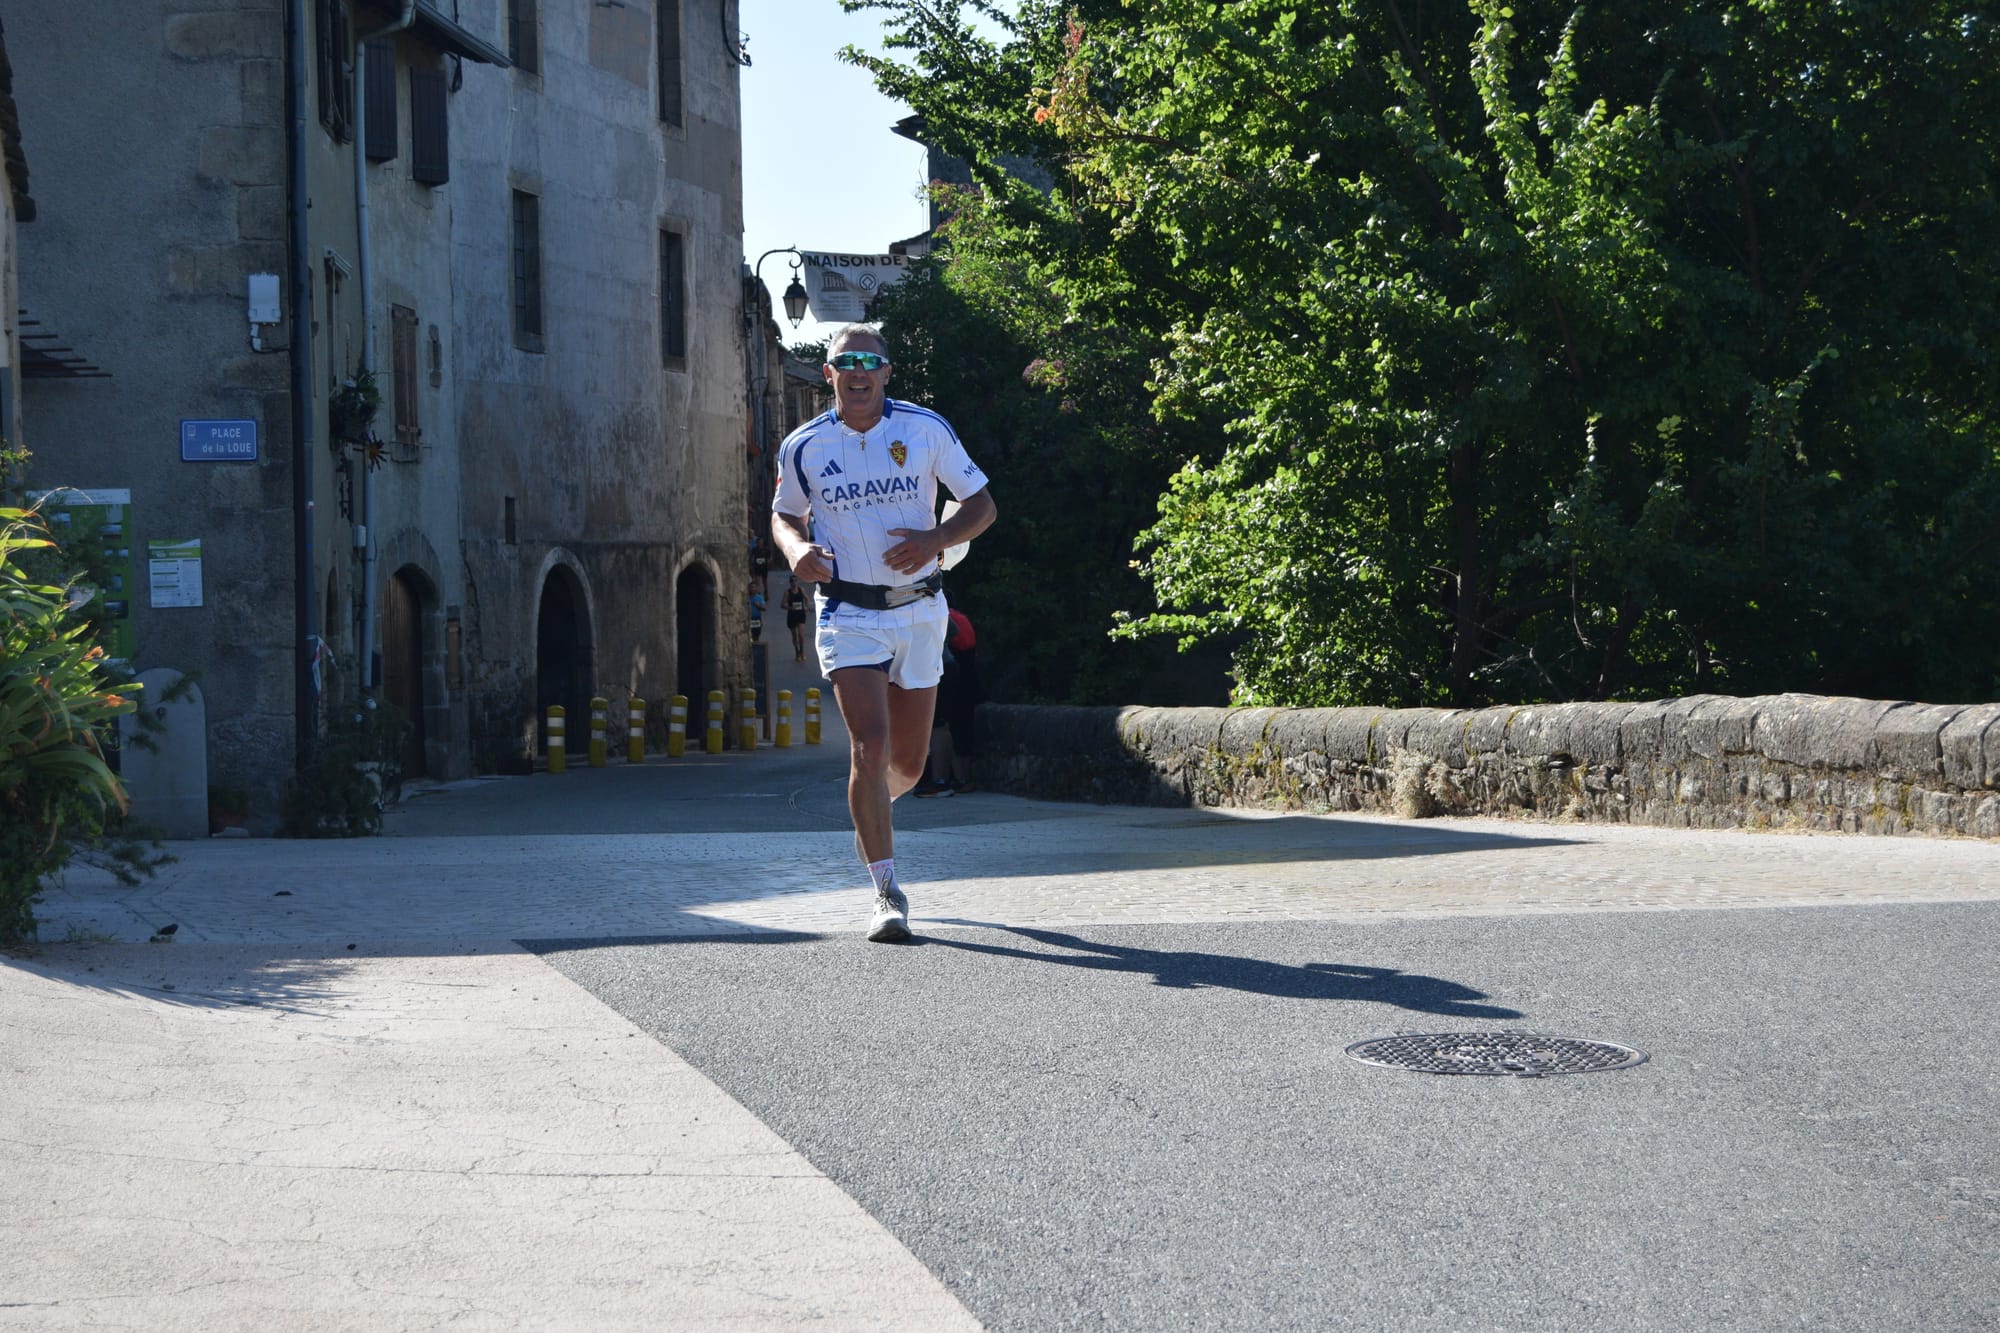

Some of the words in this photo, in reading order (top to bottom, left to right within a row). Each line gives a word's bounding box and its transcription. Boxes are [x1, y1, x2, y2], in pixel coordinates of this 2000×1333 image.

[807, 254, 878, 267] MAISON
[881, 255, 903, 266] DE
[211, 427, 241, 438] PLACE
[202, 443, 213, 453] de
[216, 443, 225, 453] la
[227, 442, 252, 453] LOUE
[821, 475, 920, 504] CARAVAN
[826, 492, 919, 513] RAGANCIAS
